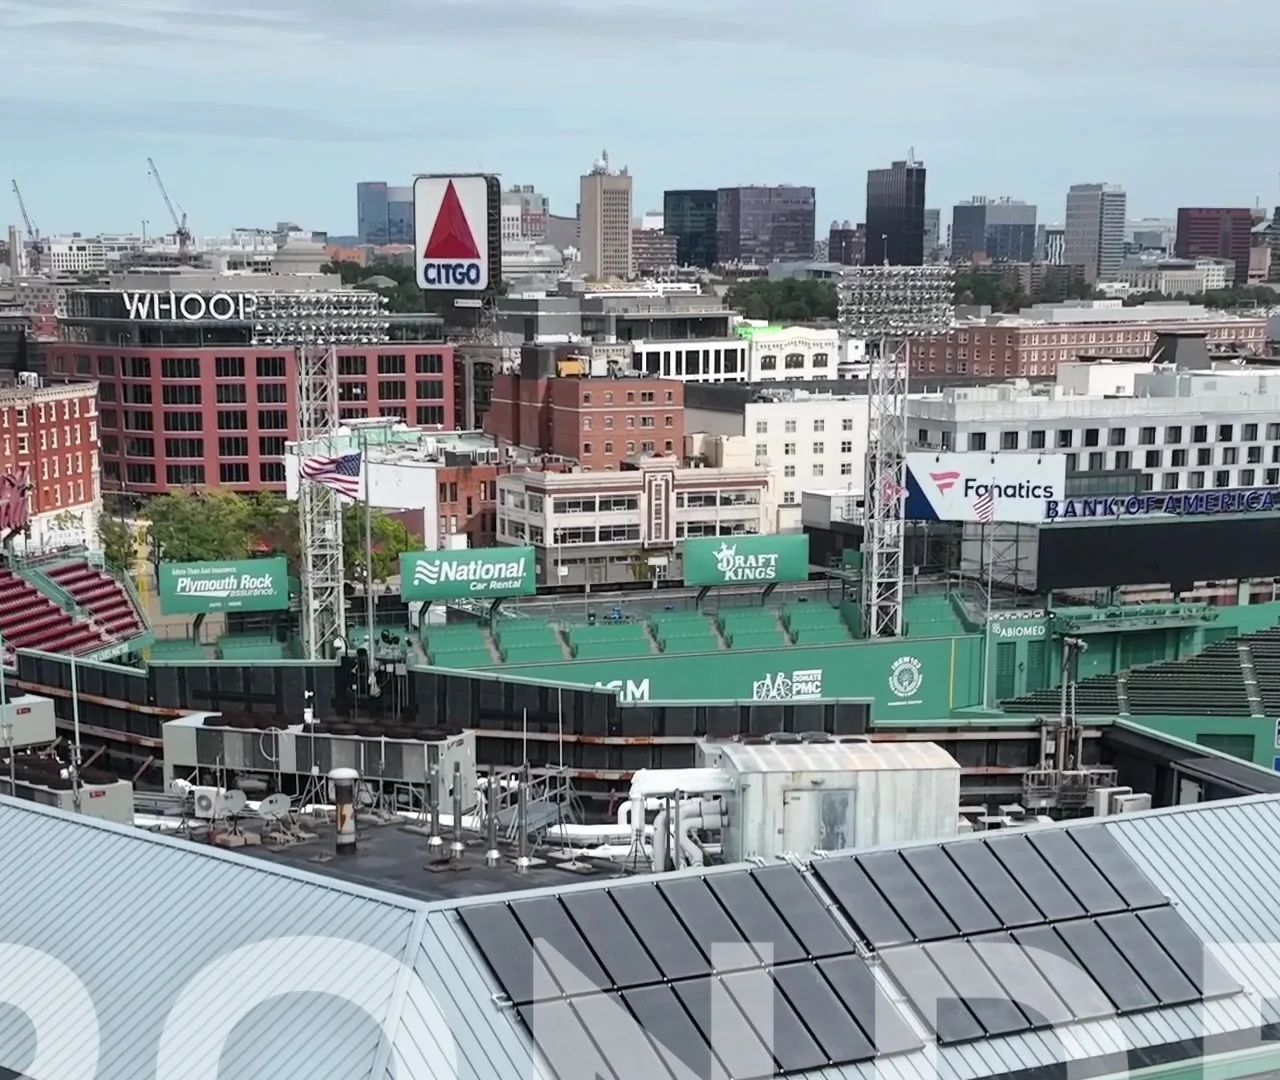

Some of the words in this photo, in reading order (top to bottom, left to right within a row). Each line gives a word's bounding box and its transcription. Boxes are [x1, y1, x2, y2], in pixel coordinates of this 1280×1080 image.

[424, 263, 480, 285] CITGO
[122, 292, 258, 321] WHOOP
[964, 478, 1055, 499] Fanatics
[1045, 499, 1117, 519] BANK
[1124, 495, 1157, 515] OF
[1162, 490, 1276, 514] AMERICA
[187, 567, 200, 575] Than
[717, 553, 779, 572] DRAFT
[724, 566, 777, 581] KINGS
[176, 574, 237, 593] Plymouth
[240, 573, 273, 590] Rock
[469, 580, 488, 591] Car
[489, 578, 522, 590] Rental
[1000, 625, 1046, 637] ABIOMED
[792, 674, 822, 682] DONATE
[792, 681, 822, 695] PMC
